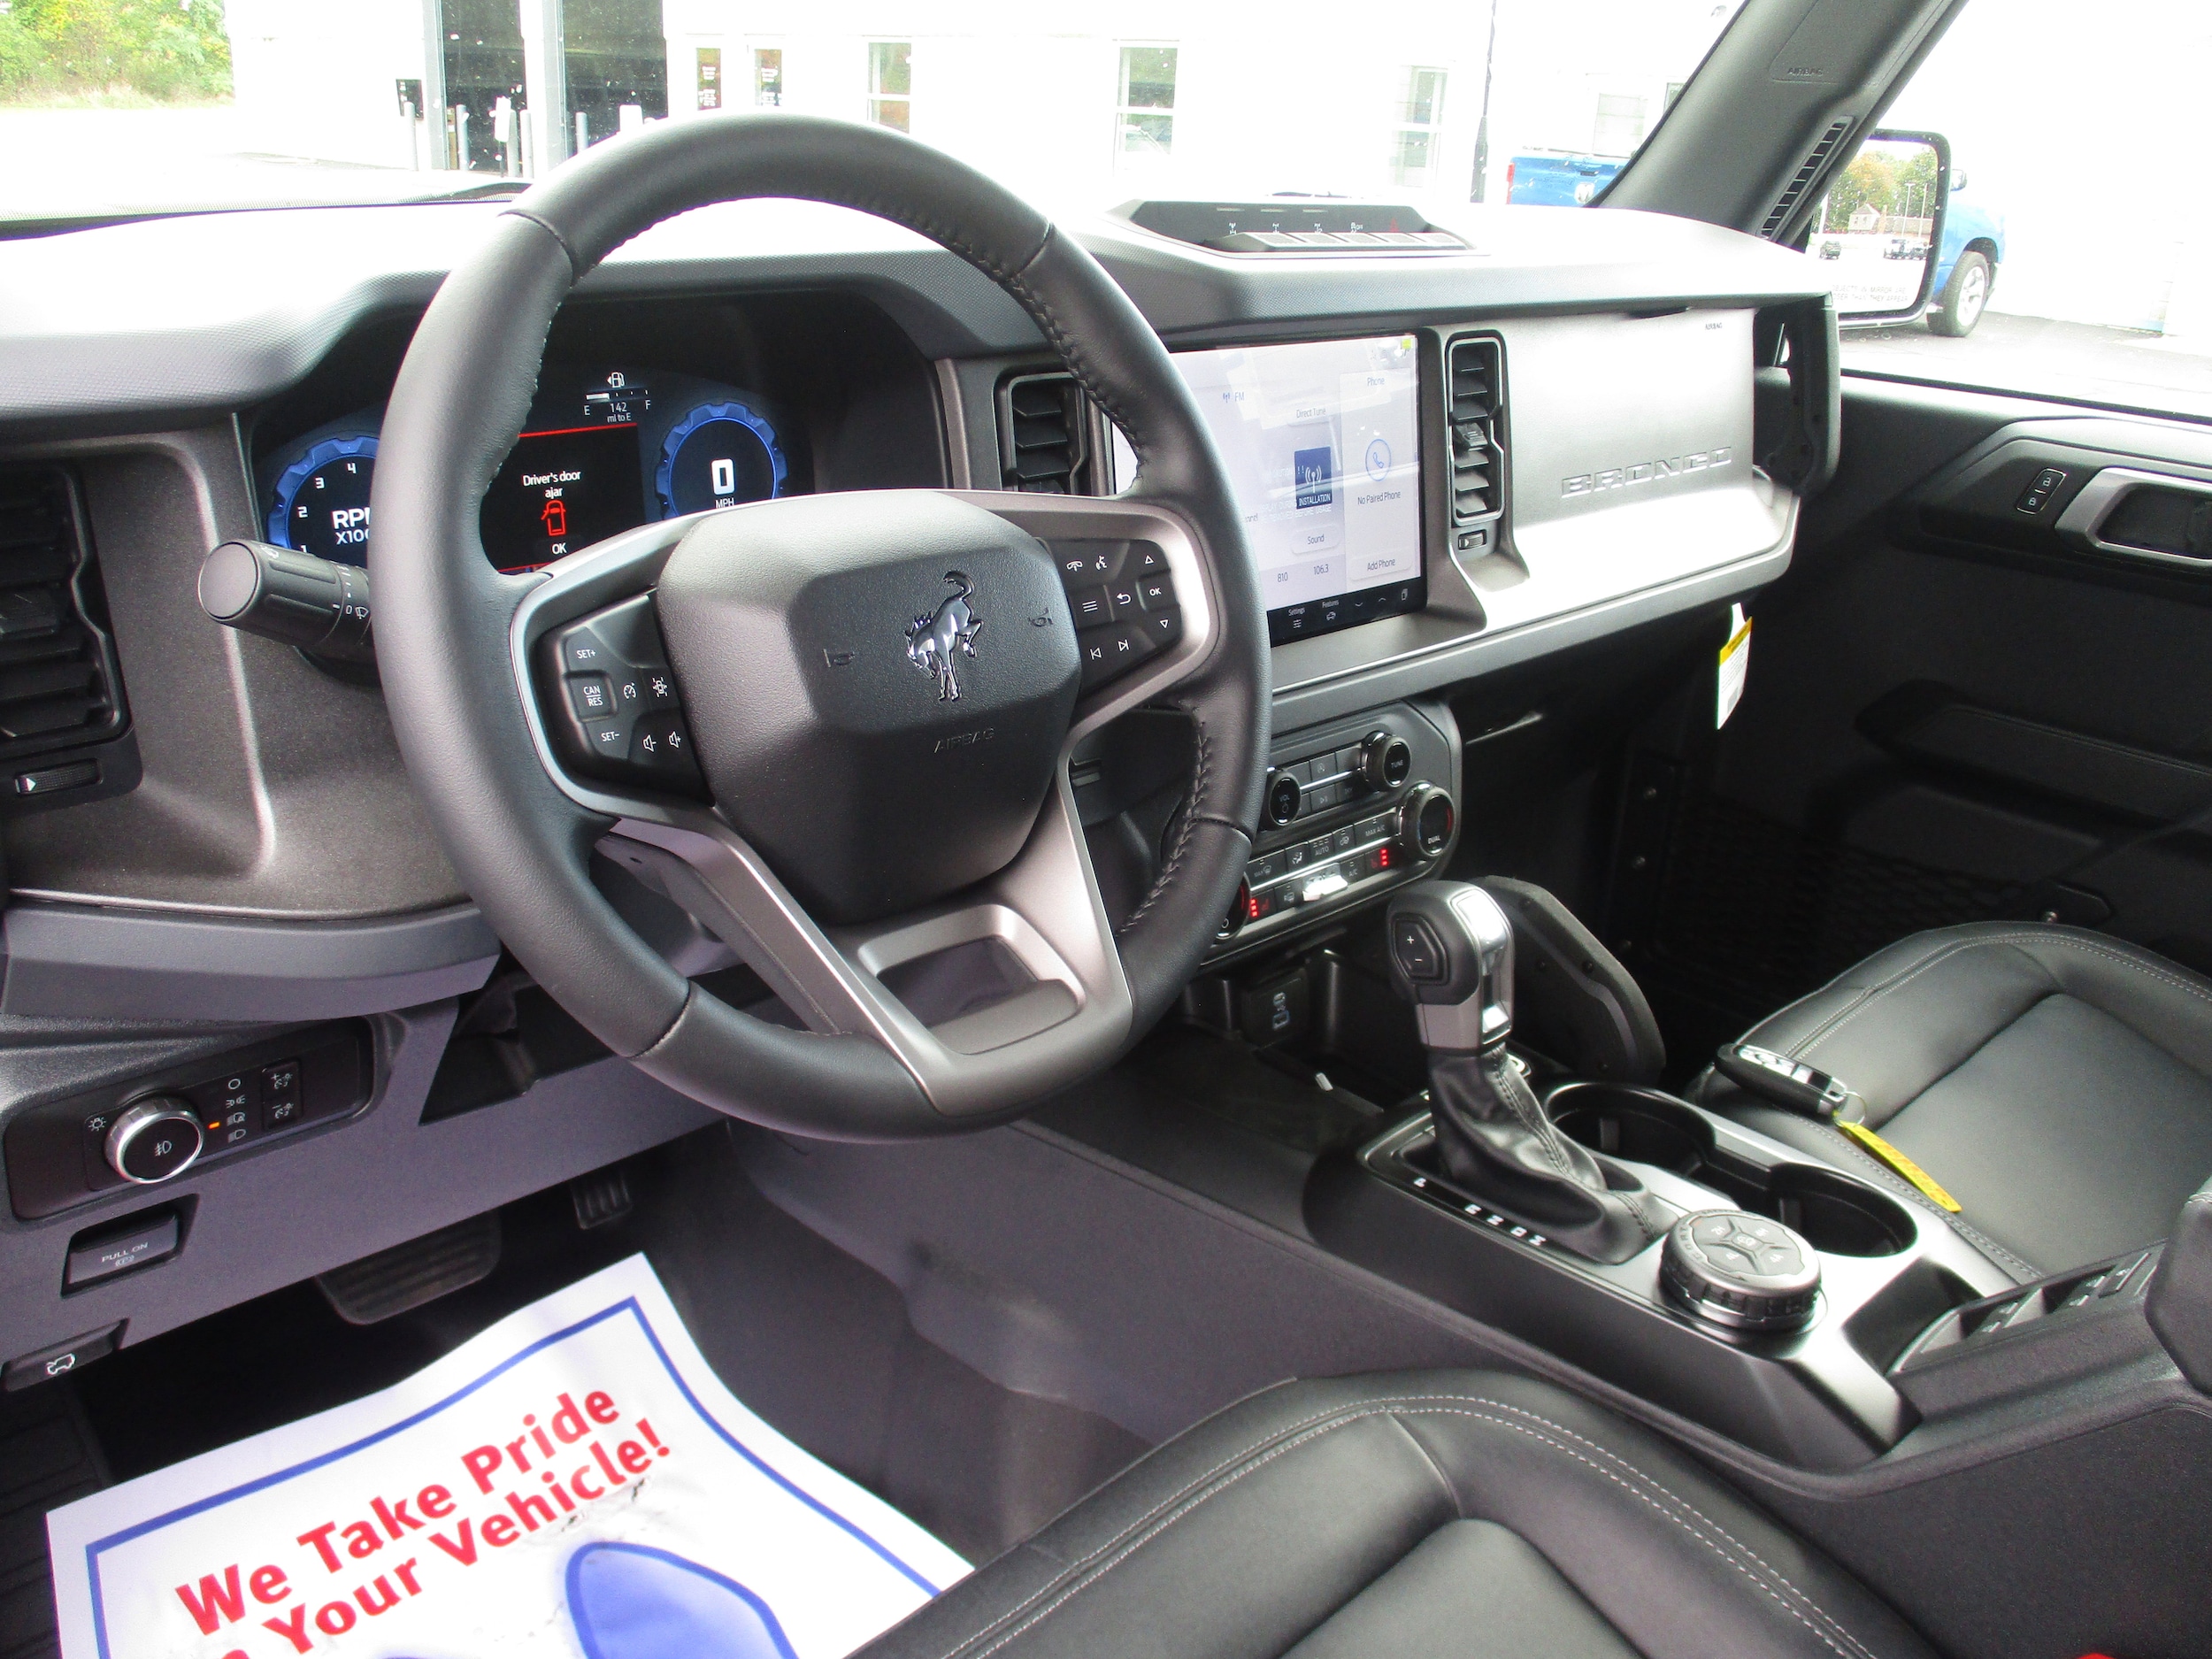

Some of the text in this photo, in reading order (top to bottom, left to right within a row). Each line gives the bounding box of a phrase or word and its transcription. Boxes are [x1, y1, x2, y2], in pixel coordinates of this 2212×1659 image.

[1367, 377, 1386, 387] Phone
[1234, 392, 1245, 402] FM
[584, 405, 590, 416] E
[610, 402, 627, 413] 142
[645, 400, 651, 410] F
[618, 413, 626, 422] to
[626, 412, 632, 421] E
[1296, 408, 1326, 419] Direct Tune
[347, 463, 357, 473] 4
[1562, 446, 1732, 499] BRONCO
[522, 470, 581, 487] Driver's door
[710, 458, 734, 495] 0
[315, 477, 325, 488] 3
[545, 487, 564, 499] ajar
[1357, 490, 1402, 505] No Paired Phone
[715, 497, 734, 509] MPH
[1299, 493, 1331, 507] INSTALLATION
[297, 506, 309, 518] 2
[332, 507, 371, 529] RP
[1307, 534, 1325, 545] Sound
[552, 542, 567, 555] OK
[1313, 565, 1329, 575] 106.3
[1367, 558, 1396, 572] Add Phone
[1277, 572, 1288, 583] 810
[1149, 587, 1162, 597] OK
[1288, 607, 1306, 617] Settings
[576, 649, 596, 659] SET+
[583, 685, 601, 695] CAN
[588, 697, 603, 707] RES
[933, 727, 995, 754] AIRBAG
[1391, 760, 1403, 769] TUNE
[1279, 794, 1289, 803] VOL
[1427, 834, 1441, 844] DUAL
[1315, 846, 1329, 856] AUTO
[1348, 868, 1358, 878] A/C
[101, 1241, 149, 1263] PULL ON
[175, 1390, 620, 1637] We Take Pride
[262, 1417, 671, 1655] Your Vehicle!
